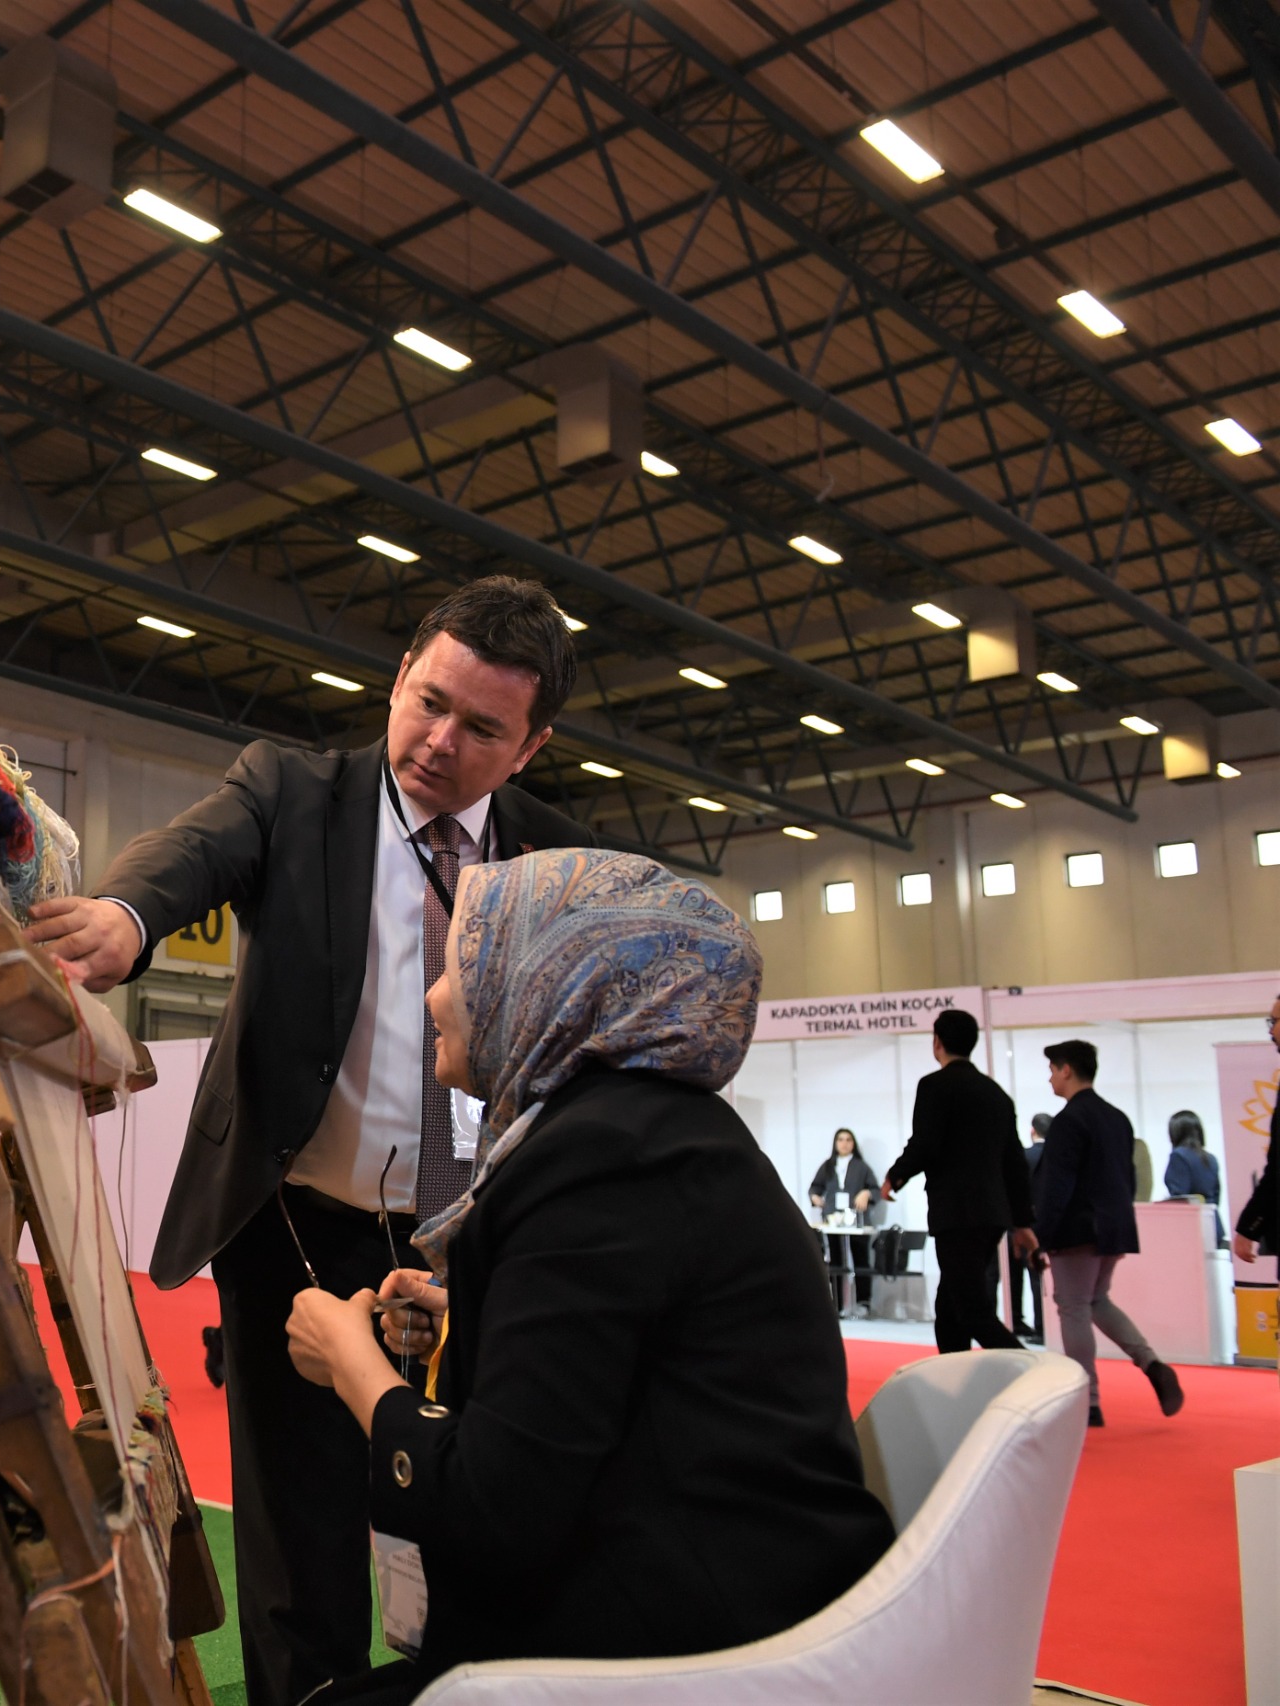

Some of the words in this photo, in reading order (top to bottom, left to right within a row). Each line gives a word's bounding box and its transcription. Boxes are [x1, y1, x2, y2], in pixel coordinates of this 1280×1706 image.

[770, 1003, 858, 1020] KAPADOKYA
[861, 996, 898, 1014] EMİN
[901, 996, 955, 1013] KOÇAK
[805, 1018, 864, 1033] TERMAL
[867, 1015, 918, 1030] HOTEL
